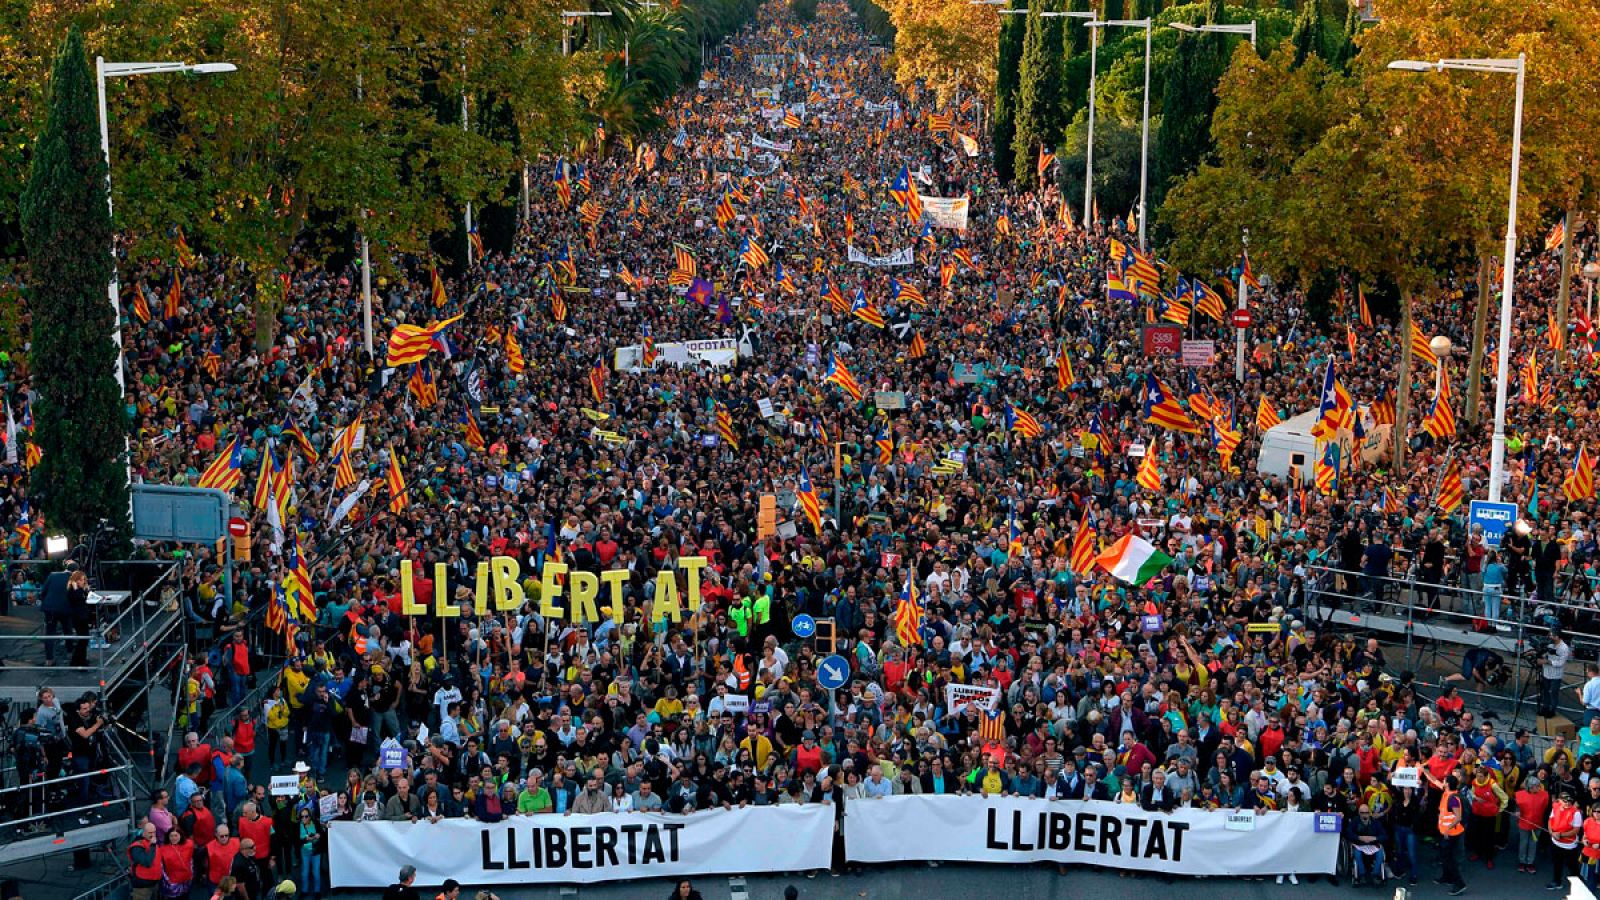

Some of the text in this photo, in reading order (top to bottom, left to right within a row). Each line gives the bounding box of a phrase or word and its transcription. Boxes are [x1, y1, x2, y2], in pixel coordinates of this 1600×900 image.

[400, 556, 707, 624] LLIBERTAT
[481, 824, 685, 870] LLIBERTAT
[986, 808, 1189, 862] LLIBERTAT
